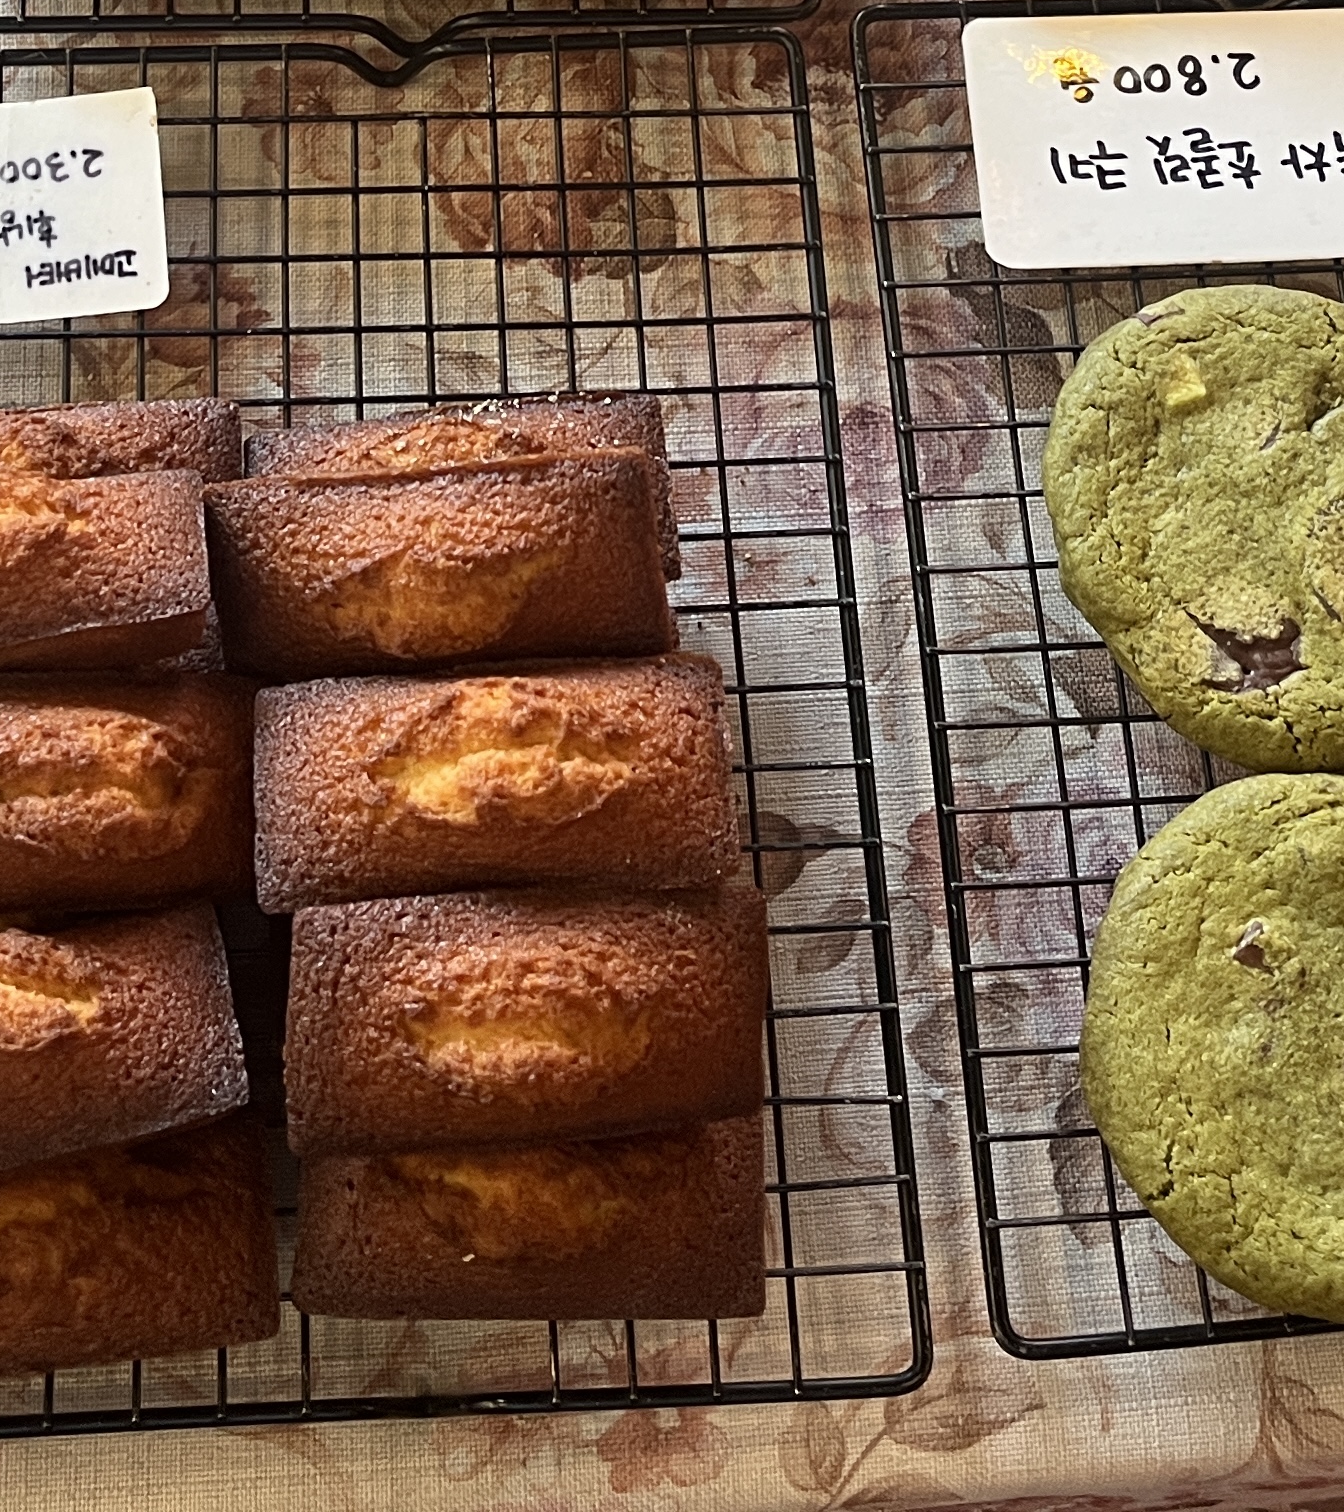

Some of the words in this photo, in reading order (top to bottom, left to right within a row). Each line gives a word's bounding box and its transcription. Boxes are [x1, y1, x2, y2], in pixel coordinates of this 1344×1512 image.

[1050, 140, 1128, 191] 쿠키
[1145, 127, 1261, 190] 초콜릿
[25, 250, 138, 288] 고메버터
